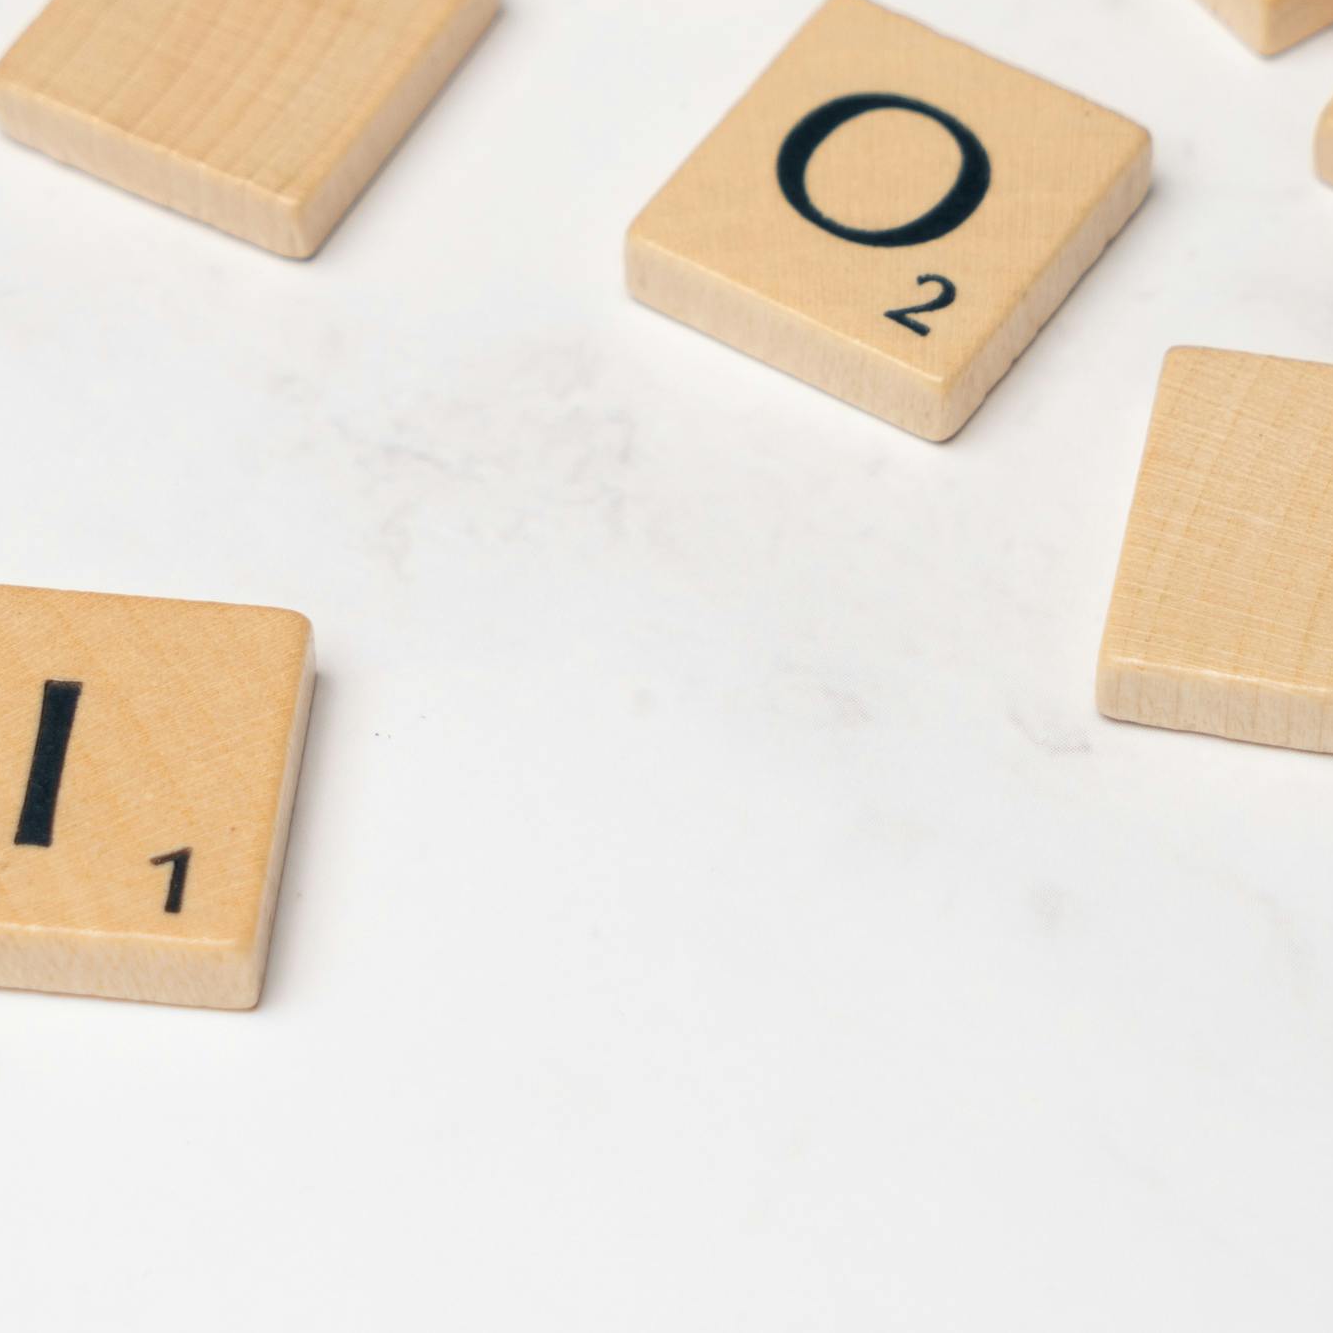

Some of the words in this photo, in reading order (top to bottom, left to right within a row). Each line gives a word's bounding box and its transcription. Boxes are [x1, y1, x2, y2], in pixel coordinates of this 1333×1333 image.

[774, 91, 993, 250] O
[882, 272, 958, 338] 2
[12, 678, 84, 849] I
[148, 846, 193, 915] 1
